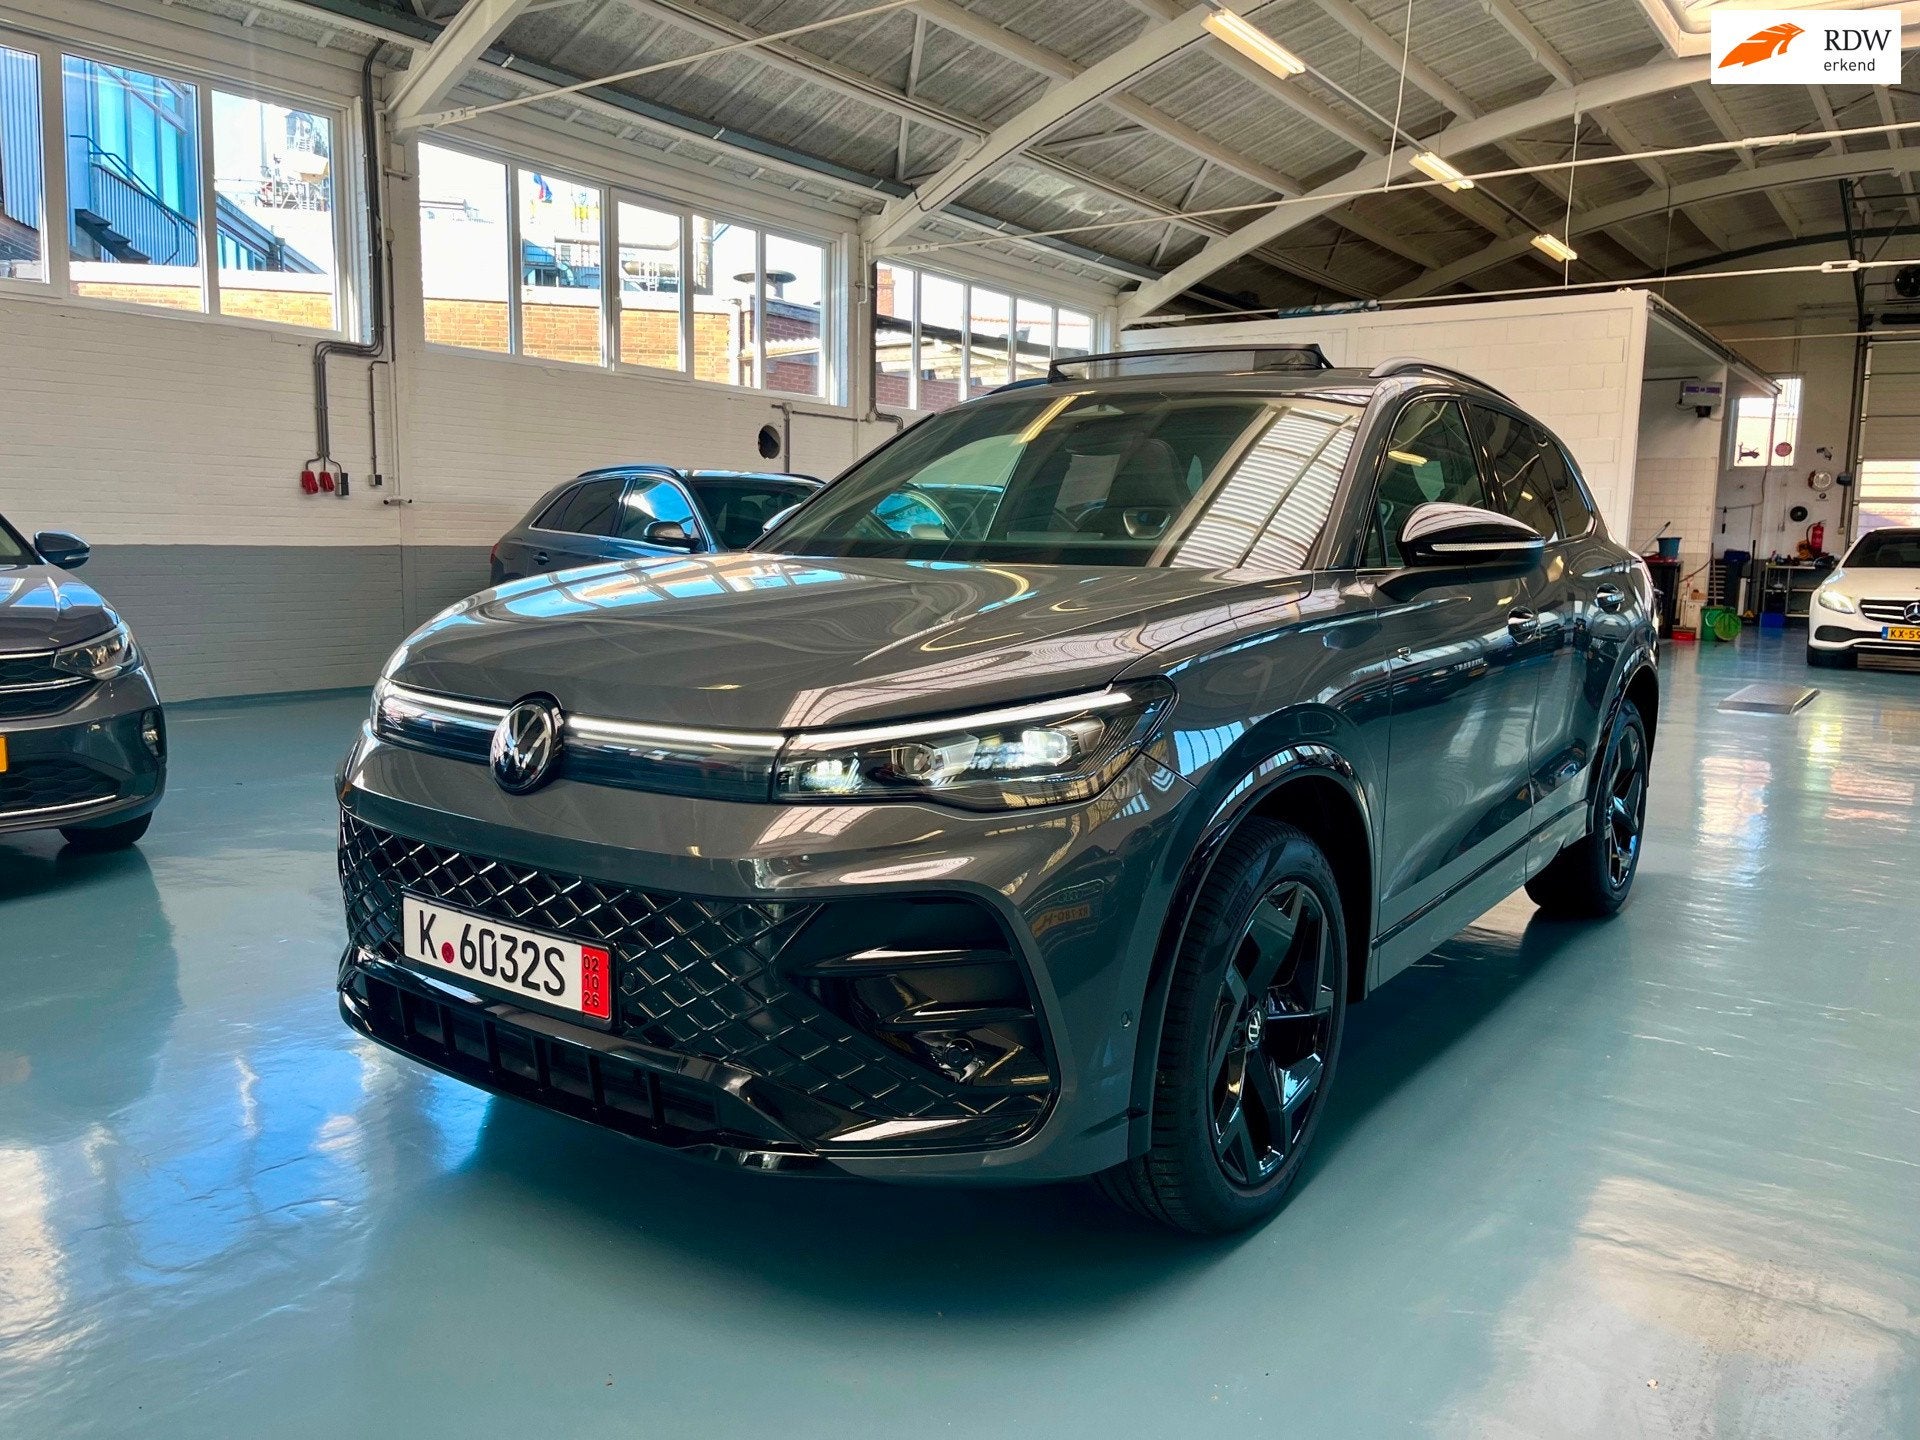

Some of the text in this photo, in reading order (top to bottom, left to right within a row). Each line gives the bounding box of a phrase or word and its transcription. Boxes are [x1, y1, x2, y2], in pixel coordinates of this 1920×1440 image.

[419, 909, 566, 997] K 6032S
[583, 954, 600, 972] 02
[584, 974, 600, 990] 10
[583, 992, 600, 1008] 26
